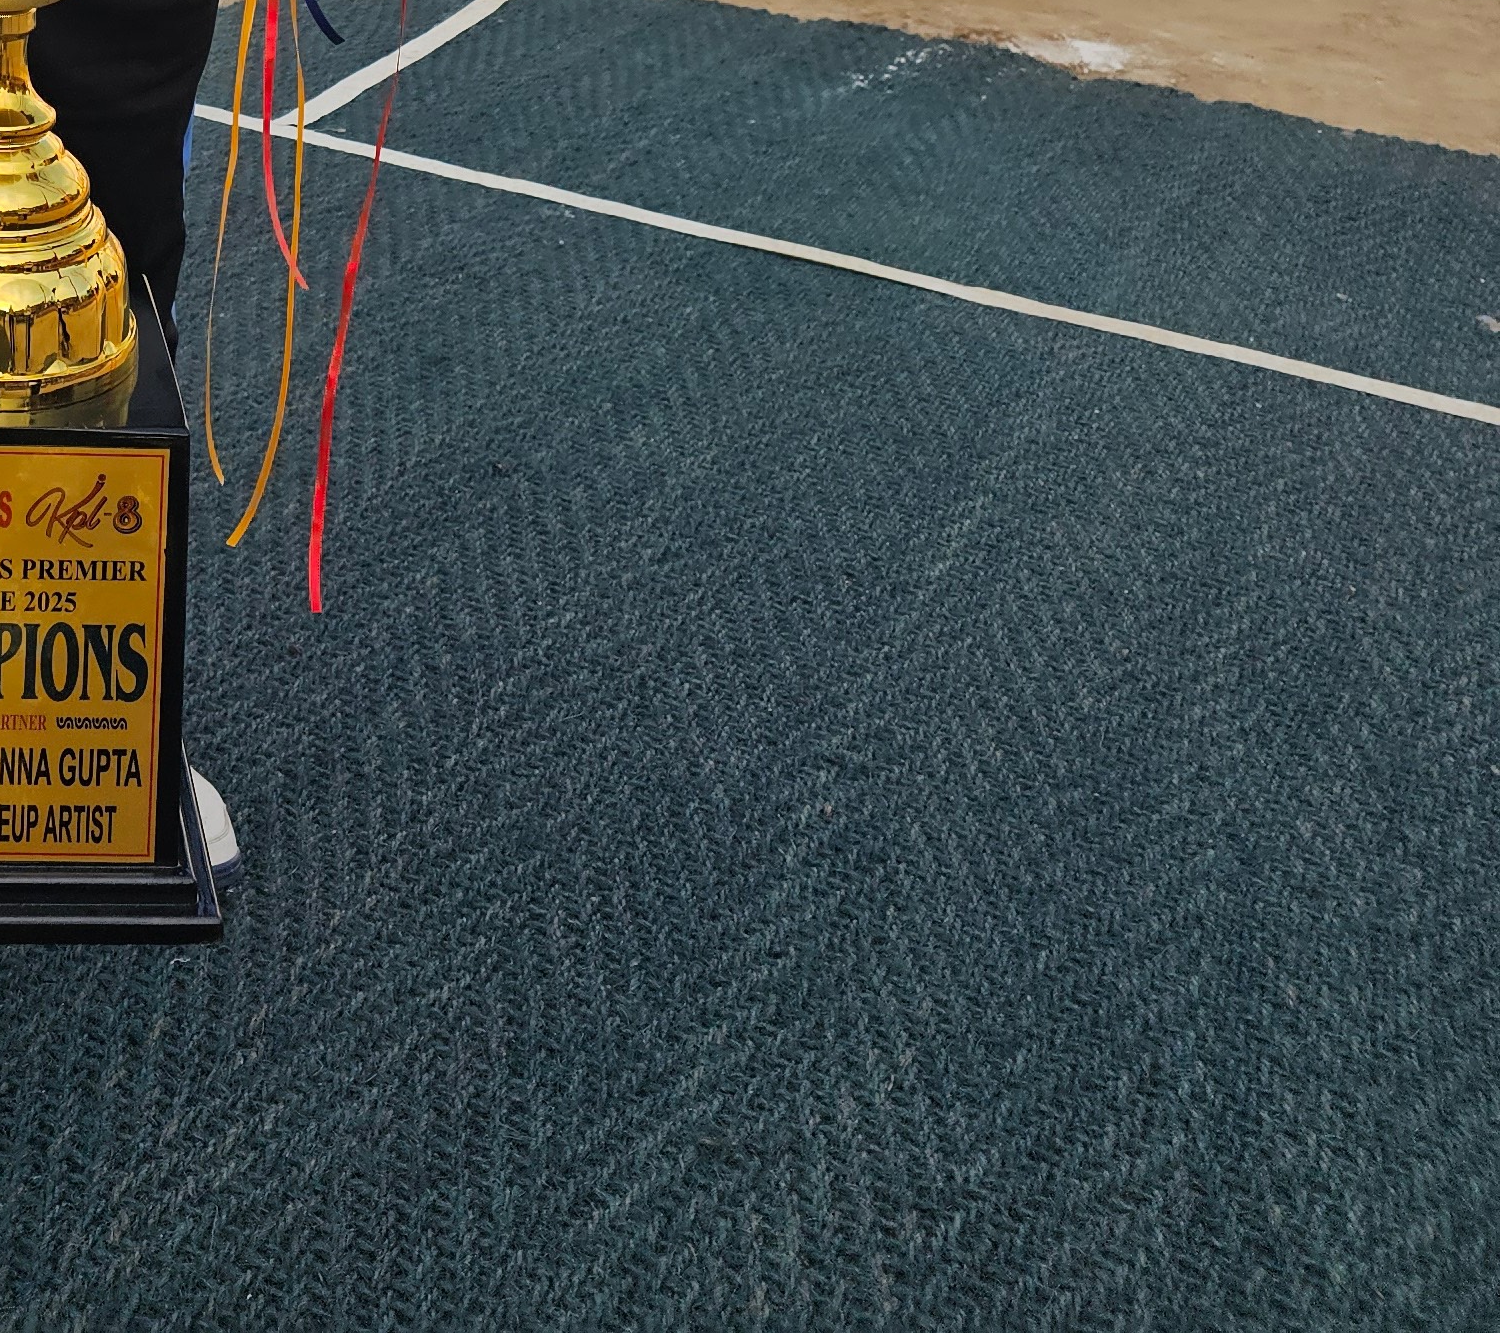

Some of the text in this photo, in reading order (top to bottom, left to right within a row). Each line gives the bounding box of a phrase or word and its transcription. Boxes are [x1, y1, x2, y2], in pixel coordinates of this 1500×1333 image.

[21, 558, 147, 581] PREMIER
[24, 591, 77, 612] 2025
[58, 748, 142, 787] GUPTA
[43, 805, 116, 844] ARTIST
